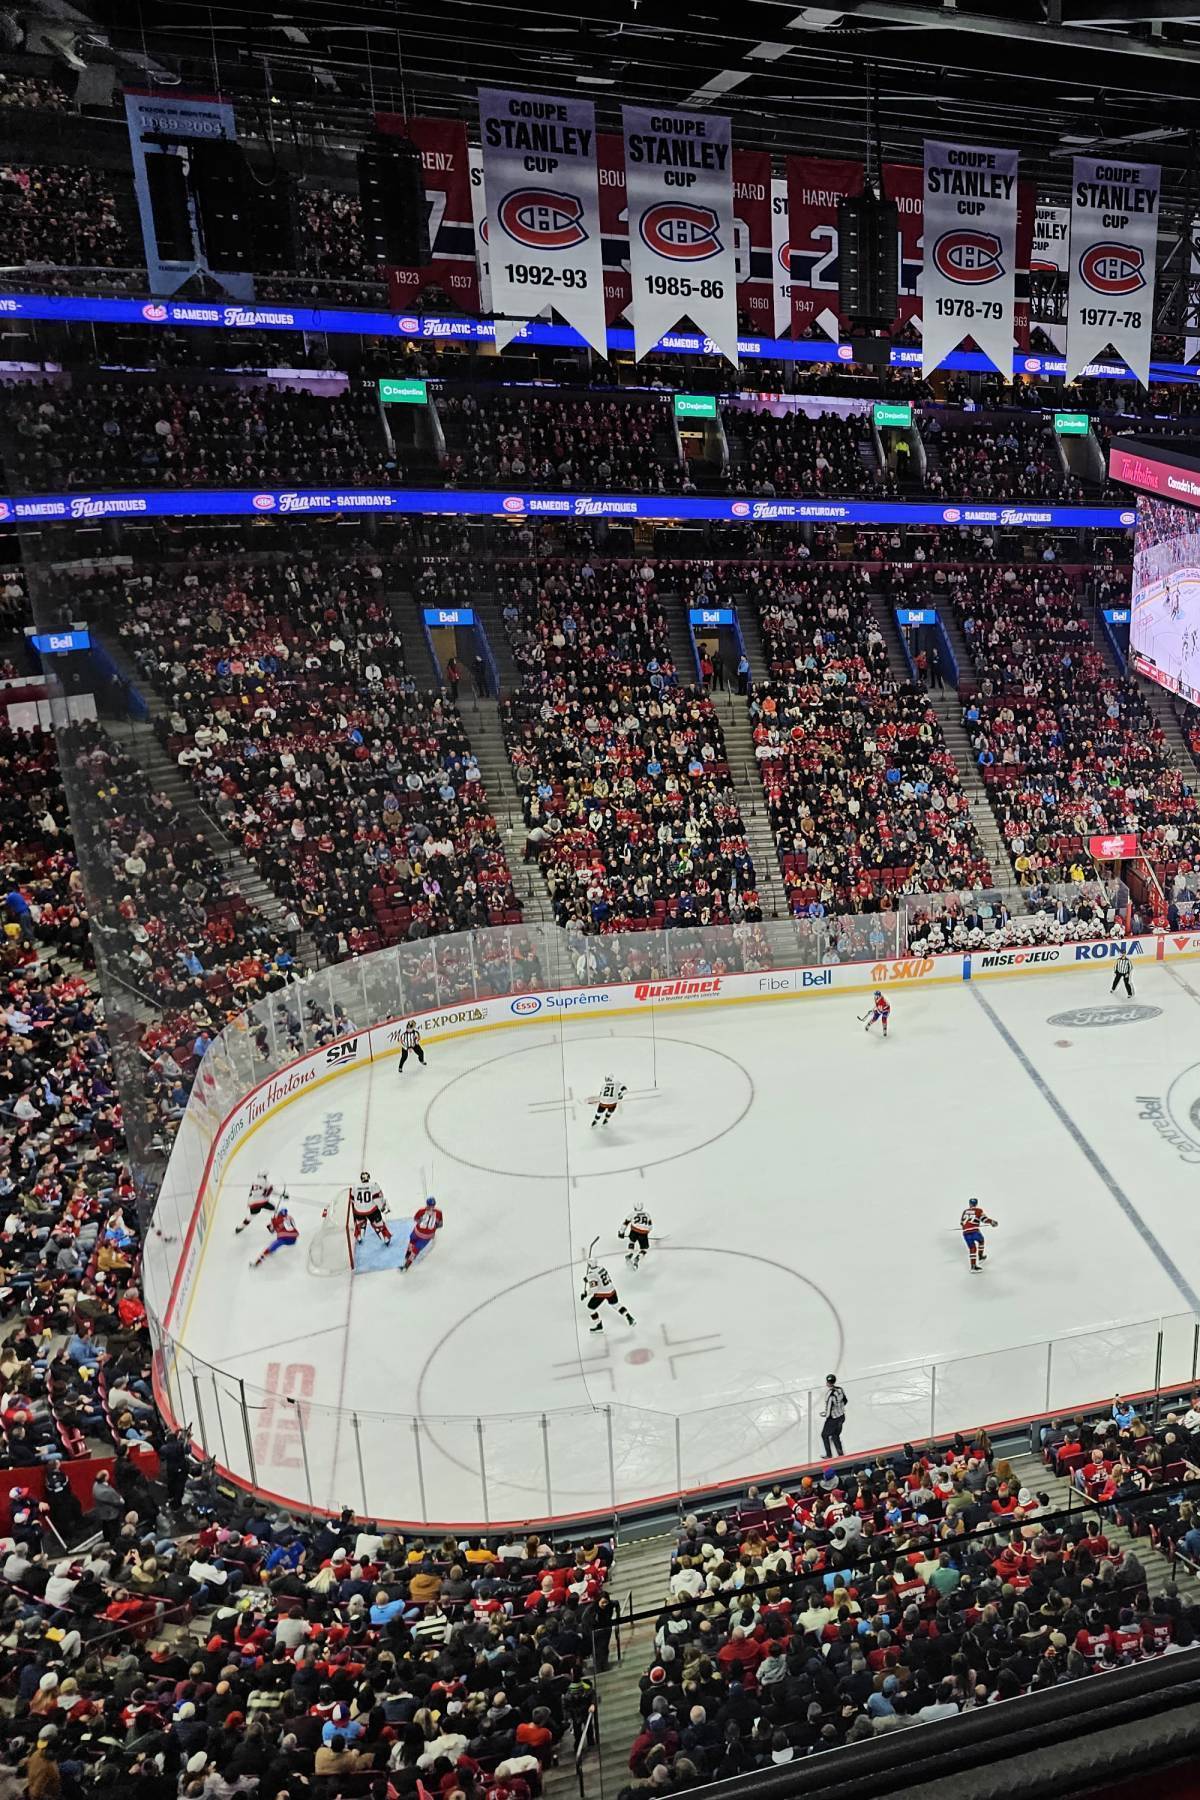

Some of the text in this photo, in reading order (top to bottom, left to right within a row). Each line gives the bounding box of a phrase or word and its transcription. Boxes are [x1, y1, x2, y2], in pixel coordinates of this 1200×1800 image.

[509, 99, 567, 122] COUPE
[651, 116, 705, 137] COUPE
[485, 118, 592, 156] STANLEY
[629, 134, 729, 170] STANLEY
[948, 150, 995, 169] COUPE
[523, 155, 558, 173] CUP
[664, 170, 696, 187] CUP
[928, 167, 1015, 200] STANLEY
[1096, 166, 1140, 183] COUPE
[1076, 182, 1157, 213] STANLEY
[957, 201, 986, 216] CUP
[1103, 214, 1129, 229] CUP
[395, 271, 472, 288] 1923 1937
[505, 263, 587, 288] 1992-93
[605, 286, 624, 299] 1941
[645, 275, 724, 299] 1985-86
[750, 297, 769, 309] 1960
[795, 301, 814, 312] 1947
[936, 298, 1003, 319] 1978-79
[1080, 308, 1142, 328] 1977-78
[71, 498, 146, 518] FanATIQUES
[279, 493, 330, 512] FanATIC
[575, 498, 637, 515] FanATIQUES
[753, 502, 795, 518] FanATIC
[439, 611, 458, 622] Bell
[702, 611, 720, 622] Bell
[908, 611, 924, 622] Bell
[1113, 611, 1127, 622] Bell
[50, 635, 73, 650] Bell
[1075, 940, 1144, 960] RONA
[889, 958, 935, 980] SKIP
[634, 977, 723, 1001] Qualinet
[759, 969, 832, 991] Fibe Bell
[516, 991, 609, 1011] Esso Suprême
[1072, 1010, 1140, 1025] Ford
[327, 1039, 358, 1066] SN
[246, 1067, 316, 1125] Tim Hortons
[322, 1112, 343, 1157] experts
[301, 1134, 322, 1173] sports
[356, 1191, 371, 1204] 40
